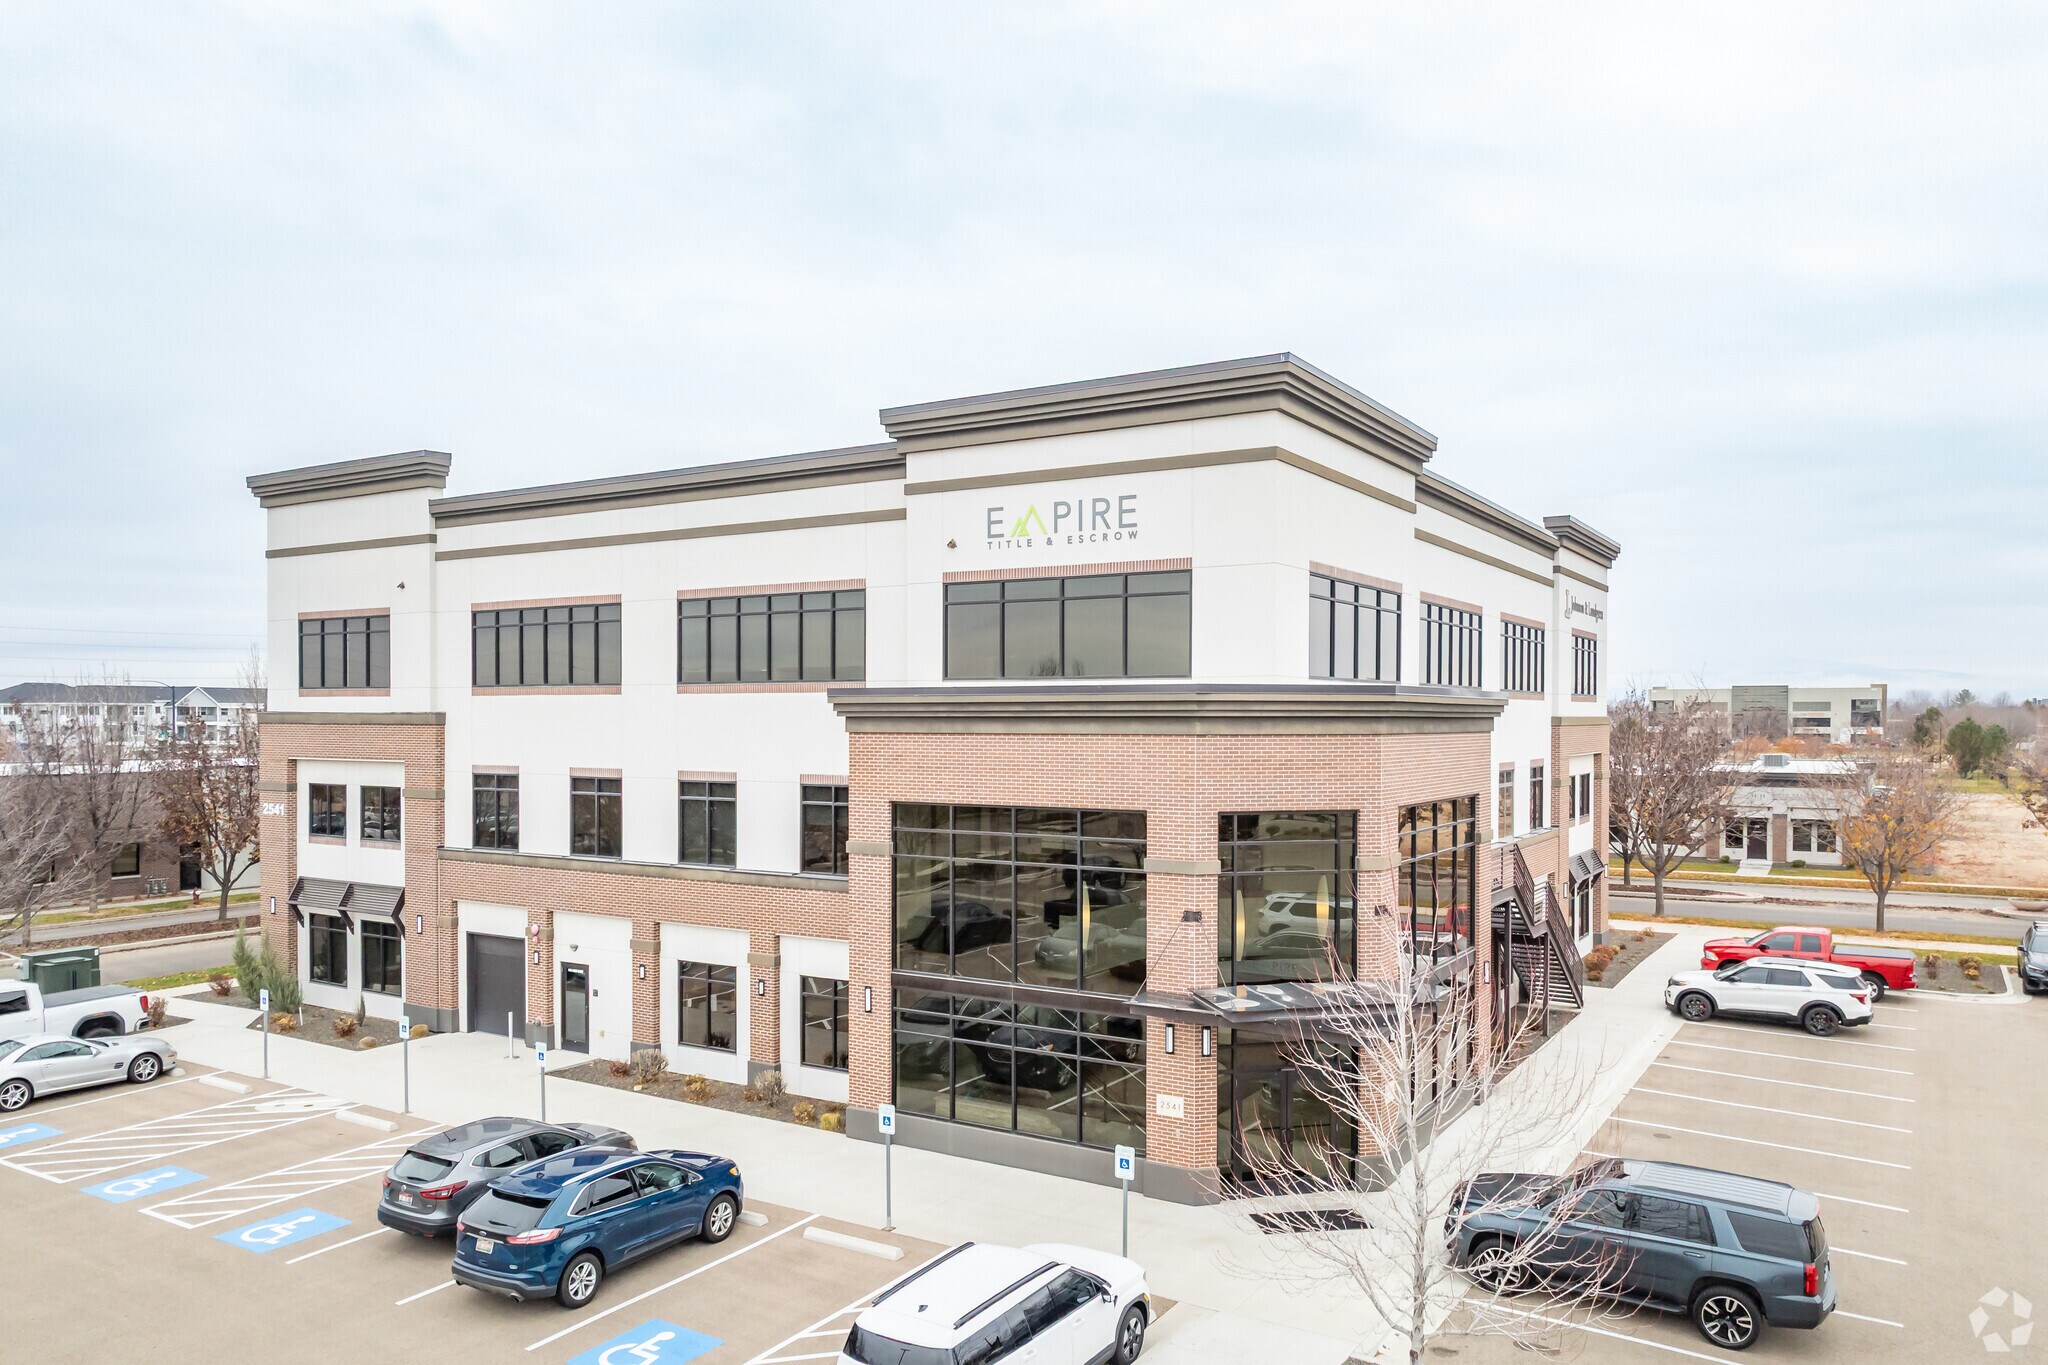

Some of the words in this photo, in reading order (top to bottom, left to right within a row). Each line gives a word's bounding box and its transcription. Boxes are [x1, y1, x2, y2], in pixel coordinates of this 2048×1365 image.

[987, 538, 1033, 550] TITLE
[1046, 536, 1053, 546] &
[1067, 530, 1138, 544] ESCROW
[262, 802, 285, 816] 2541
[1160, 1100, 1181, 1111] 2541
